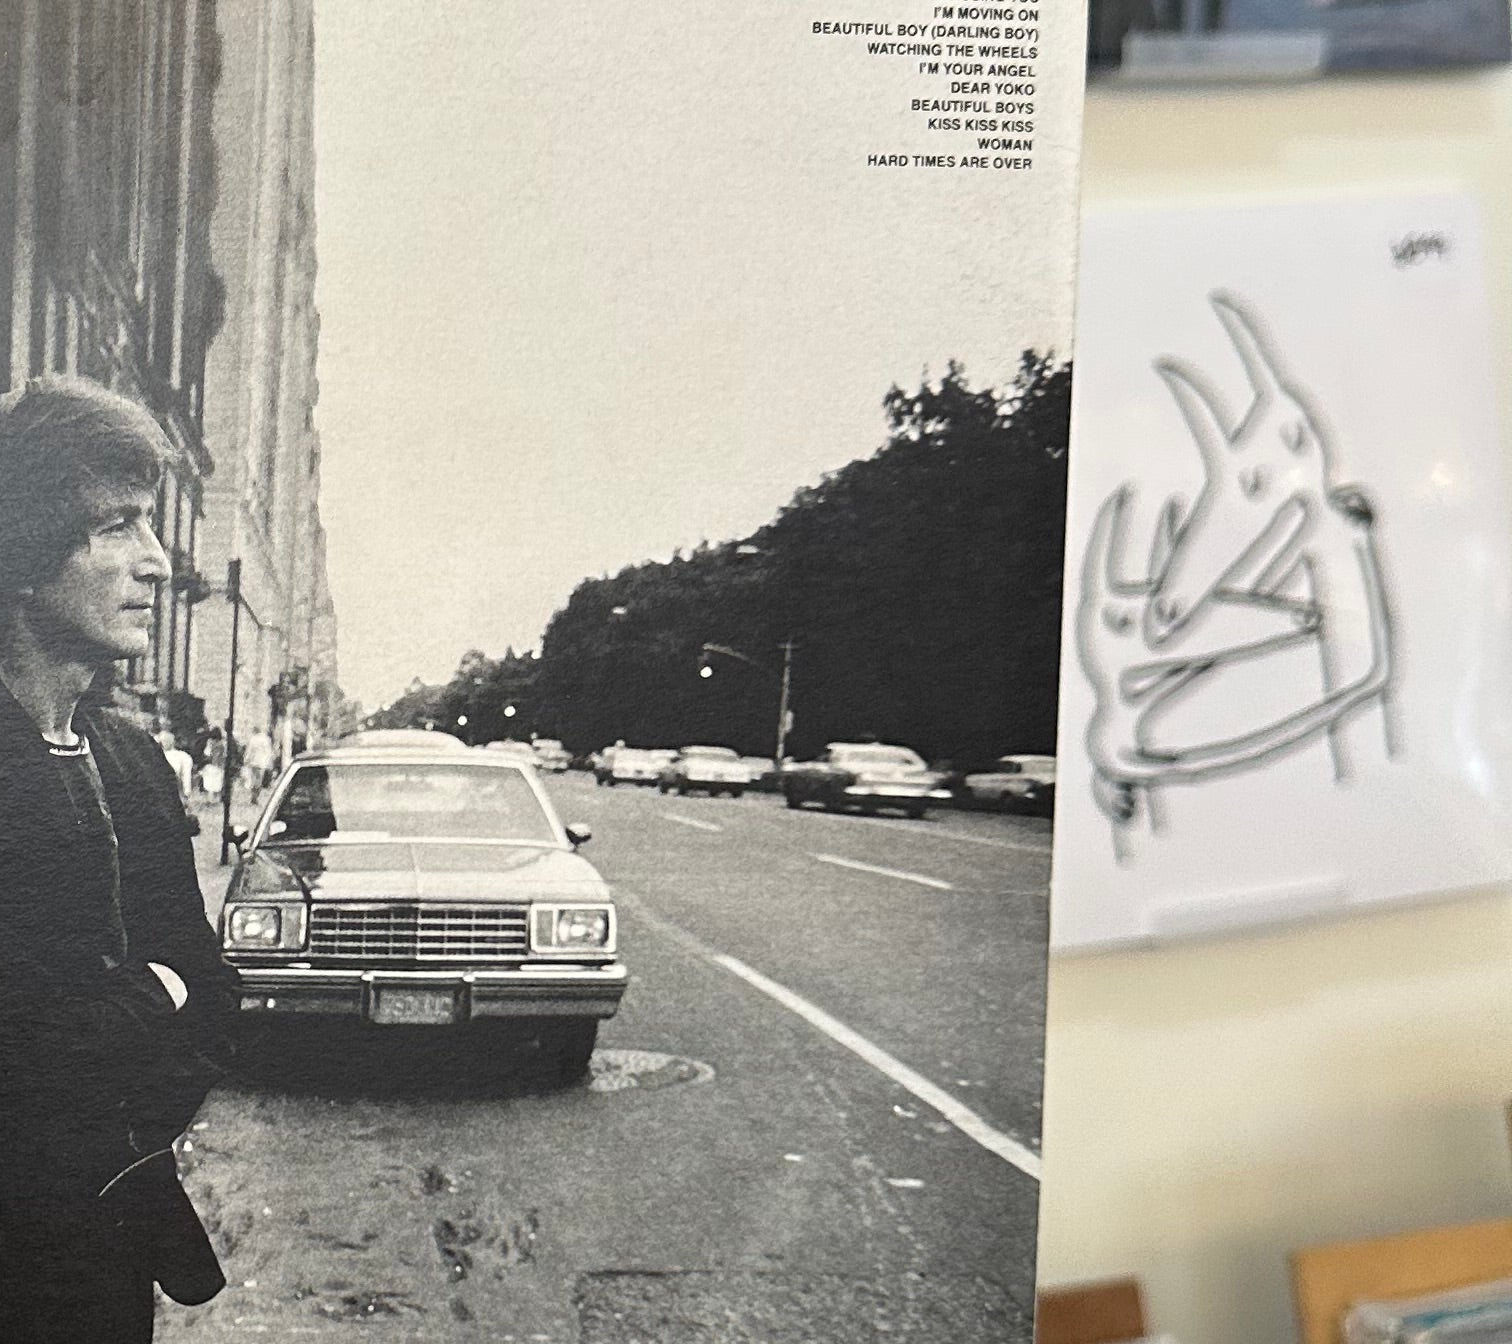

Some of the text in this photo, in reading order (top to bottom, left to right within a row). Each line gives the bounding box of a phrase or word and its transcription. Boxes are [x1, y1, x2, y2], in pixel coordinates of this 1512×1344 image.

[933, 6, 1039, 22] I'M MOVING ON
[812, 21, 1039, 43] BEAUTIFUL BOY (DARLING BOY)
[867, 42, 1039, 60] WATCHING THE WHEELS
[919, 62, 1036, 78] I'M YOUR ANGEL
[951, 81, 1035, 97] DEAR YOKO
[911, 98, 1035, 115] BEAUTIFUL BOYS
[927, 117, 1034, 133] KISS KISS KISS
[977, 137, 1033, 151] WOMAN
[867, 154, 1033, 170] HARD TIMES ARE OVER
